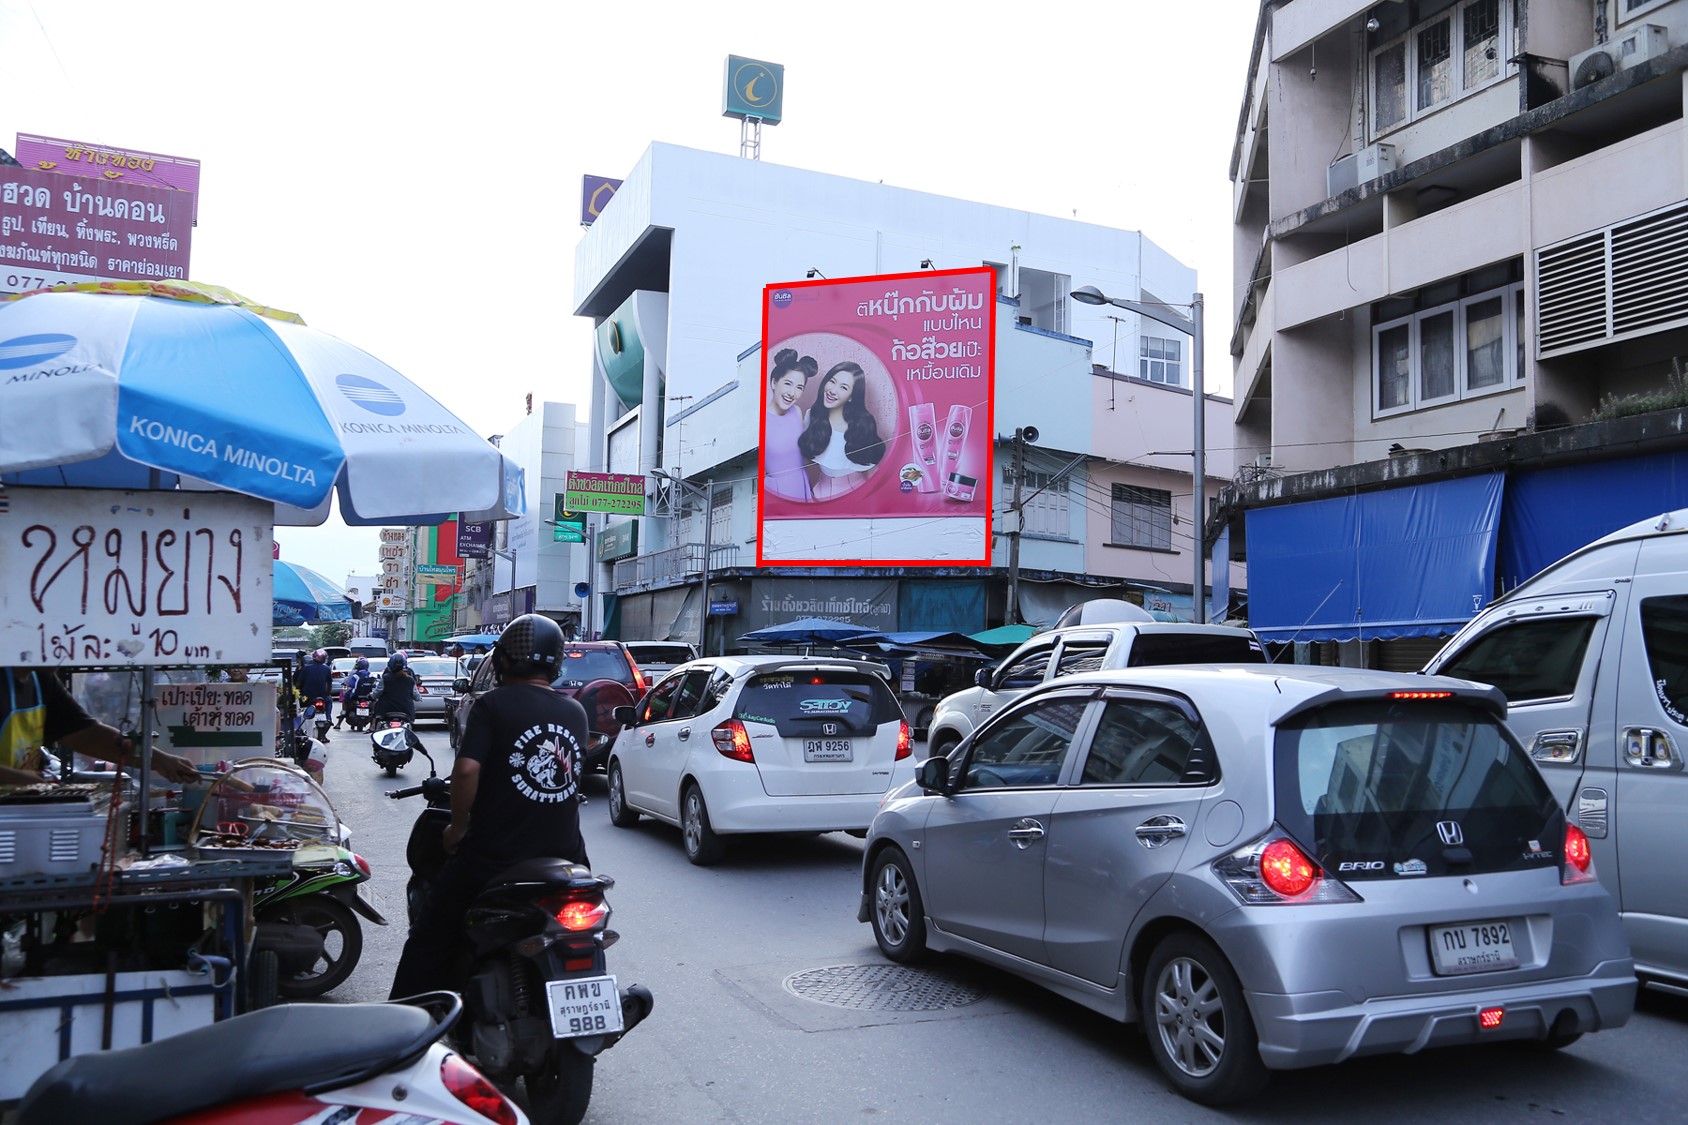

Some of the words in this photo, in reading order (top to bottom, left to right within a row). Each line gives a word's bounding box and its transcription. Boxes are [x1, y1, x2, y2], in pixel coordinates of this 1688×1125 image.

[0, 182, 51, 209] ฮวด
[64, 182, 166, 224] บ้านดอน
[31, 216, 69, 238] เทียน,
[127, 231, 178, 251] พวงหรีด
[107, 258, 184, 279] ราคาย่อมเยา
[7, 274, 78, 289] 077-
[923, 313, 982, 332] แบบไหน
[339, 421, 399, 434] KONICA
[401, 423, 466, 435] MINOLTA
[129, 415, 220, 458] KONICA
[223, 443, 317, 488] MINOLTA
[591, 498, 642, 509] 077-272295
[465, 525, 482, 533] SCB
[149, 628, 179, 657] 10
[223, 689, 253, 706] ทอด
[224, 711, 254, 726] ทอด
[513, 724, 543, 750] FIRE
[547, 723, 582, 759] RESCUE
[825, 740, 849, 752] 9256
[511, 773, 578, 804] SURATTHANI
[1338, 860, 1385, 872] BRIO
[1472, 924, 1510, 947] 7892
[1457, 950, 1501, 966] สราษฎร์ธานี
[560, 1001, 611, 1019] สุราษฎร์ธานี
[570, 1015, 607, 1033] 988
